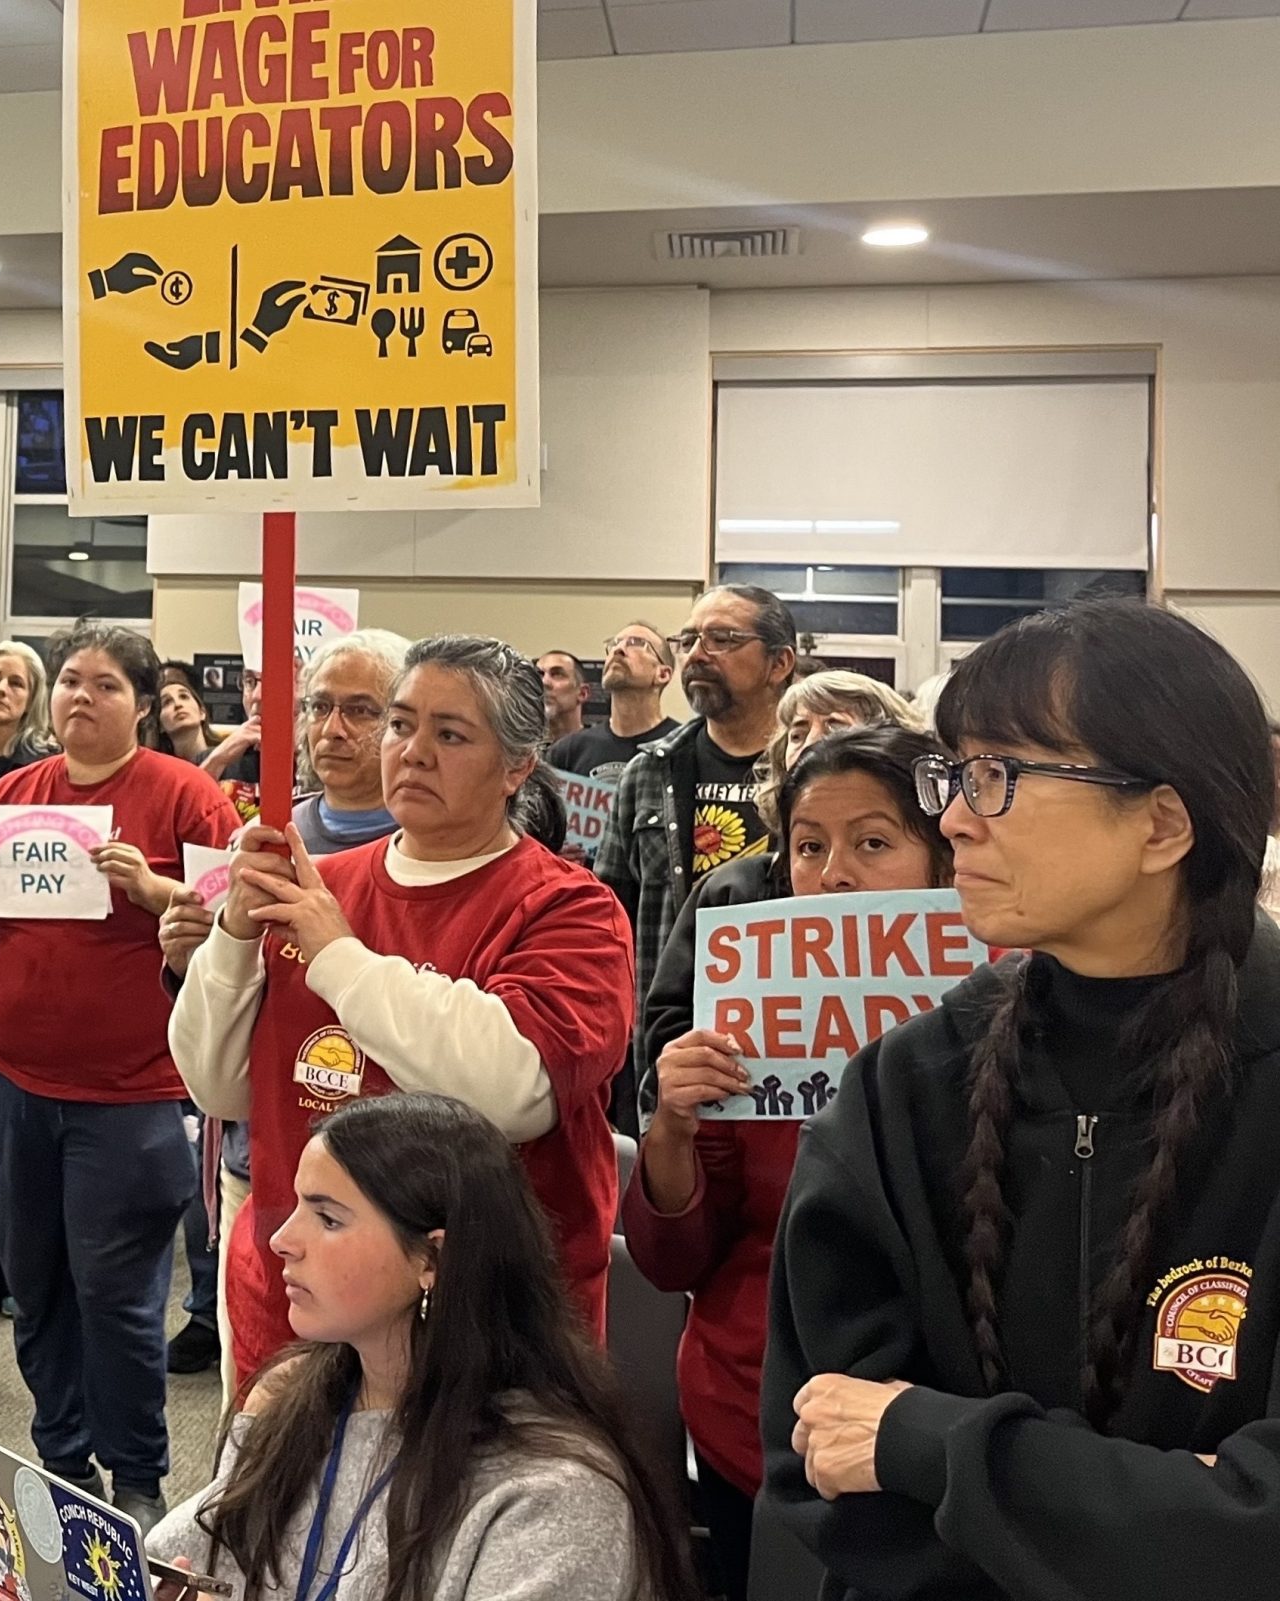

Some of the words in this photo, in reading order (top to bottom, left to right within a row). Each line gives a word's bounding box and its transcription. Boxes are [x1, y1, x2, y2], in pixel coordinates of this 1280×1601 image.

[127, 10, 330, 117] WAGE
[338, 27, 435, 95] FOR
[98, 91, 514, 216] EDUCATORS
[85, 414, 166, 483] WE
[181, 409, 339, 481] CAN'T
[355, 403, 506, 477] WAIT
[12, 842, 68, 862] FAIR
[20, 874, 65, 894] PAY
[705, 911, 974, 984] STRIKE
[714, 995, 935, 1060] READ
[305, 1066, 349, 1089] BCCE
[298, 1097, 333, 1112] LOCAL
[1146, 1286, 1163, 1307] The
[1157, 1258, 1204, 1290] bedrock
[1205, 1256, 1219, 1268] of
[1220, 1256, 1253, 1278] Berke
[1166, 1293, 1190, 1327] COUNCIL
[1187, 1285, 1200, 1296] OF
[1199, 1281, 1248, 1298] CLASSIFIED
[59, 1504, 87, 1523] CONCH
[86, 1509, 133, 1560] REPUBLIC
